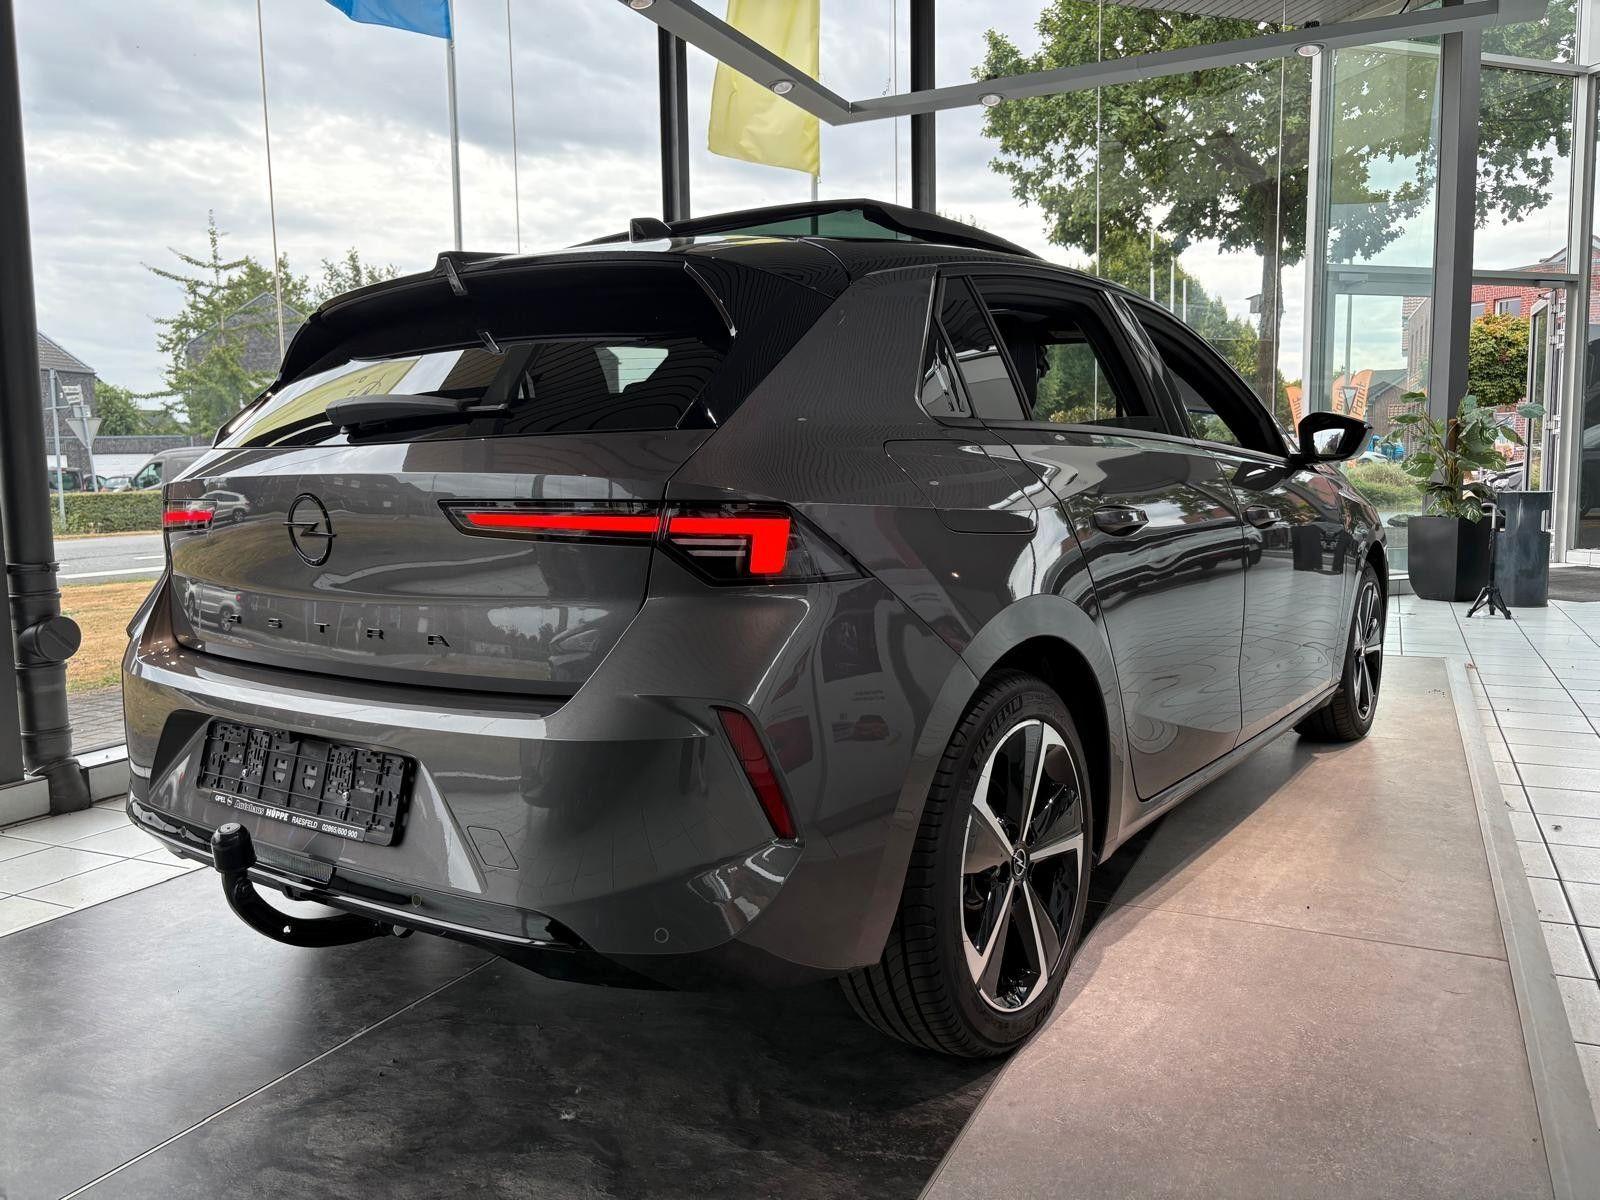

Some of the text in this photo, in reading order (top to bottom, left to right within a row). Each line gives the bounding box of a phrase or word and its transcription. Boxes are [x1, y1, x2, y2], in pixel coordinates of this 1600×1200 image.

[228, 614, 450, 648] ASTRA
[972, 695, 1023, 768] MICHELIN
[214, 794, 226, 804] OPEL
[234, 799, 265, 815] Autohaus
[291, 815, 318, 829] RAESFELD
[347, 828, 358, 839] 900
